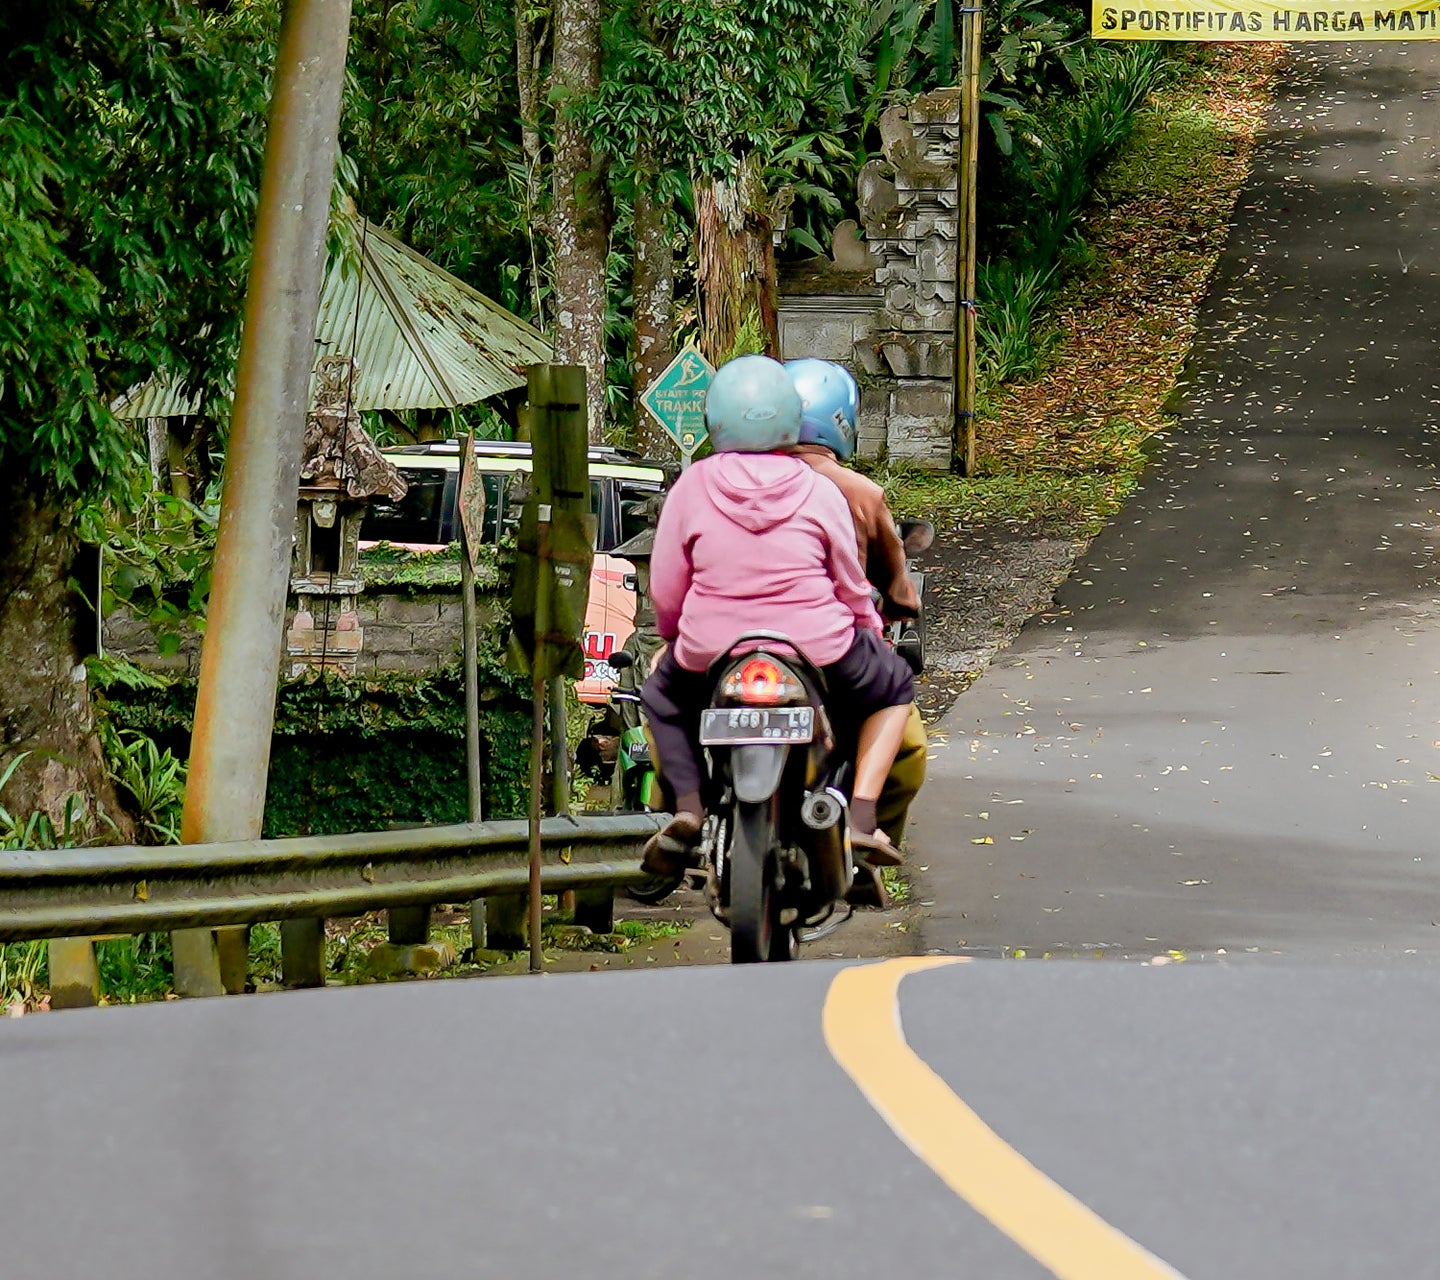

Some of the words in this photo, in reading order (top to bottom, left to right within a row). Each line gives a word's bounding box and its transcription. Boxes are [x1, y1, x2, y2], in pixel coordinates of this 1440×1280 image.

[1101, 7, 1263, 32] SPORTIFITAS
[1273, 10, 1365, 32] HARGA
[656, 400, 704, 413] TRAKK
